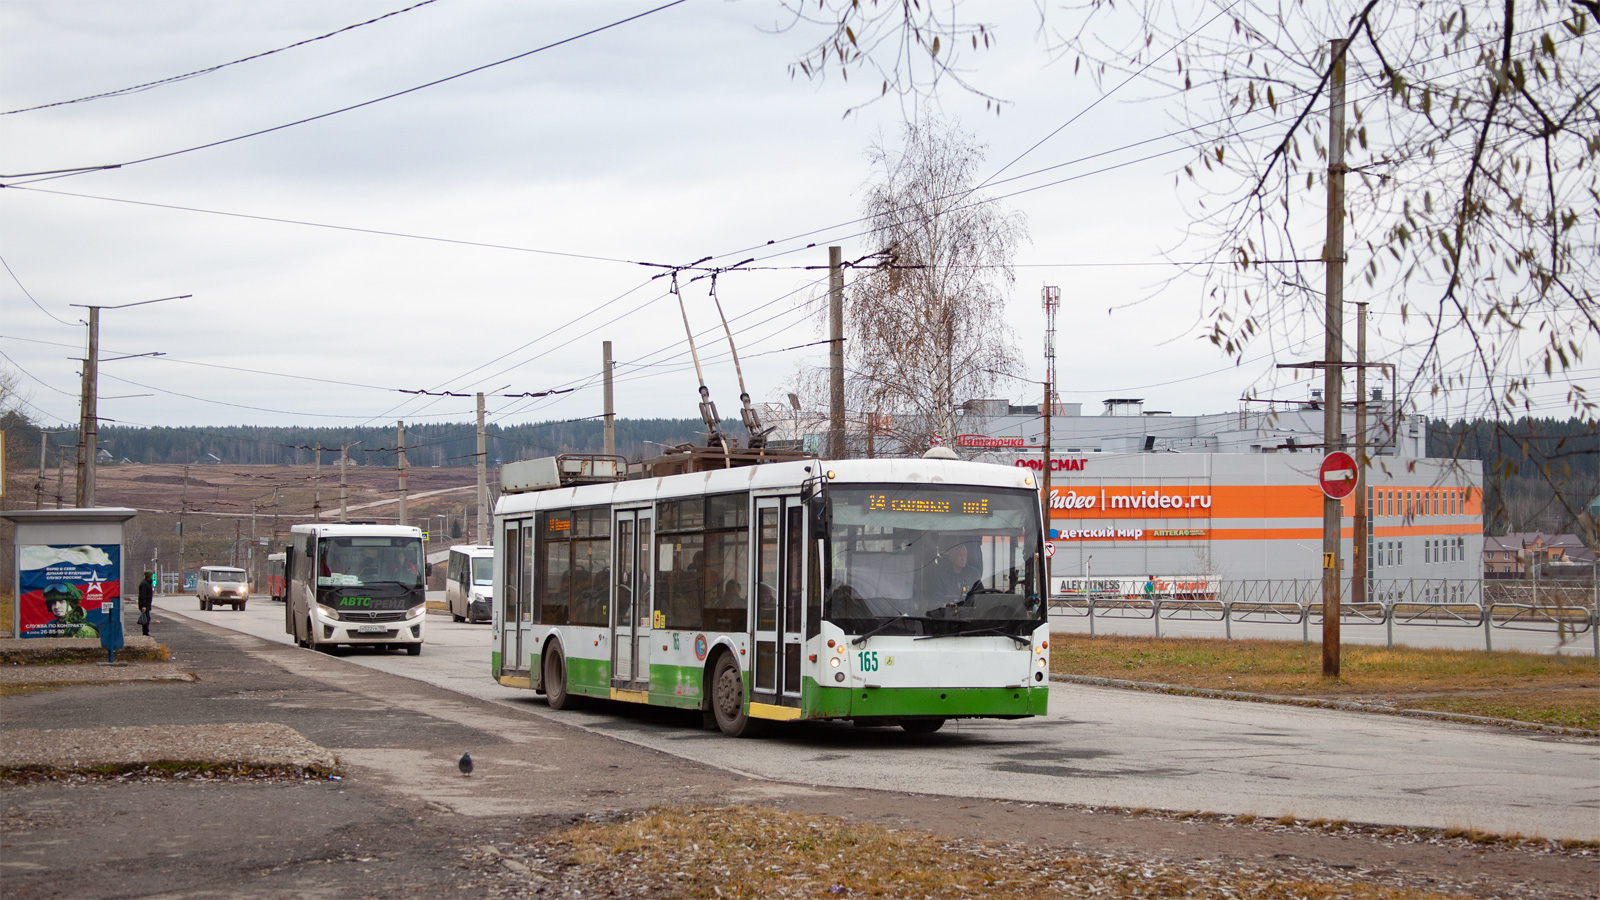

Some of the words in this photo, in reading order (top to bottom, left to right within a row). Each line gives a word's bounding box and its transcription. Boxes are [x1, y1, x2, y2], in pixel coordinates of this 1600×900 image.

[1111, 490, 1212, 508] mvideo.ru
[1060, 526, 1115, 539] детский
[1117, 529, 1143, 540] мир
[1061, 580, 1082, 590] ALEX
[858, 651, 878, 672] 165
